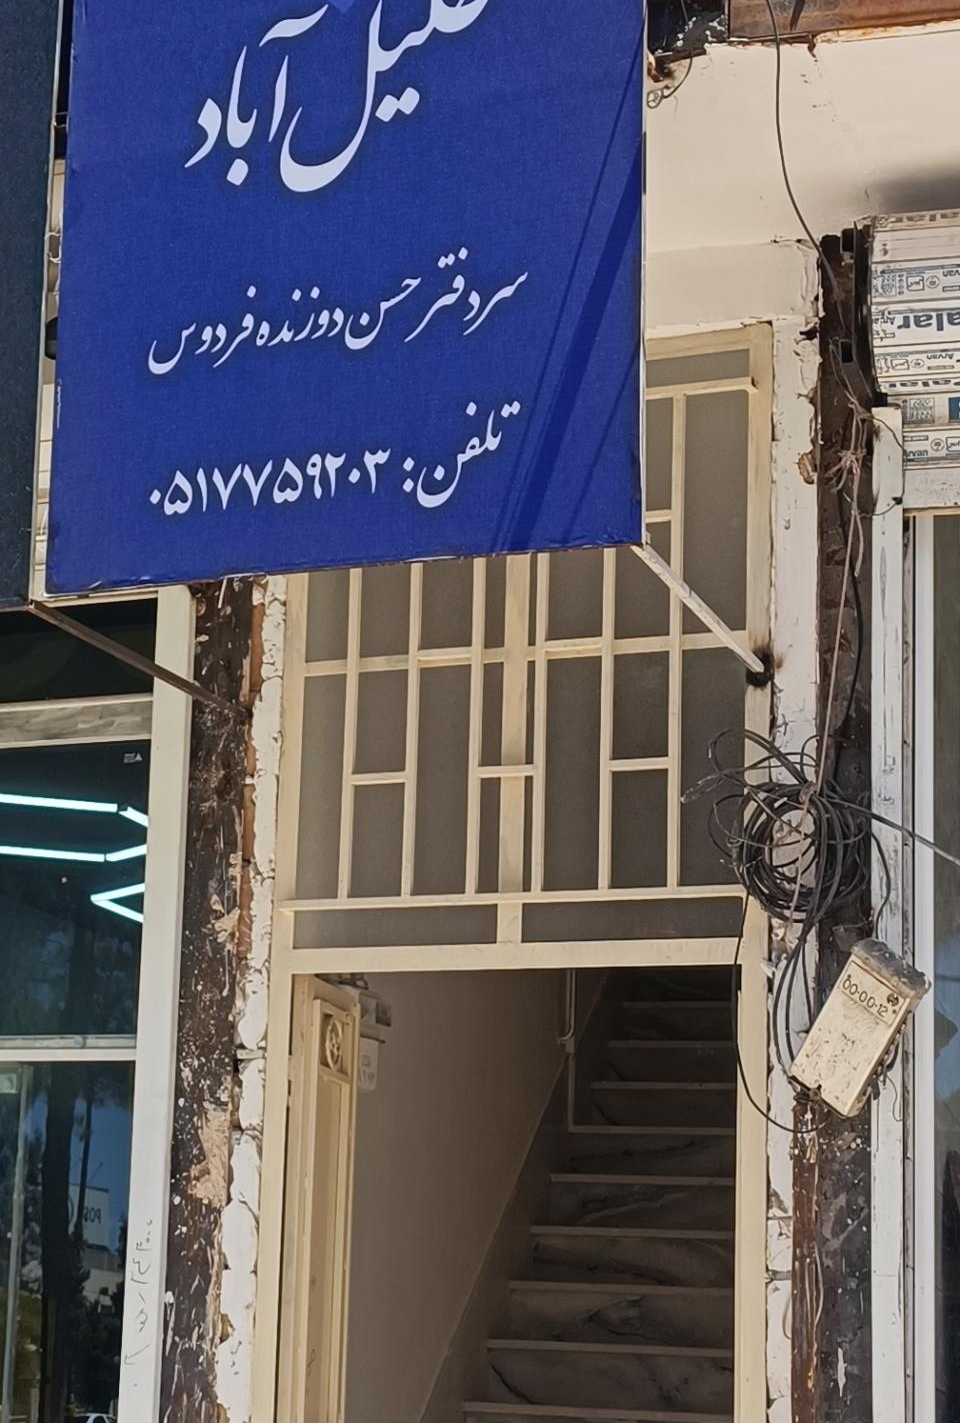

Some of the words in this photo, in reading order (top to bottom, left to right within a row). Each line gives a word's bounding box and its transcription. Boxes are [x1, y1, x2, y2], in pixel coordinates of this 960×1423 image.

[184, 4, 329, 186] آباد
[148, 285, 255, 375] فردوس
[346, 276, 422, 350] حسن
[897, 311, 960, 333] alar
[149, 448, 391, 515] ۰۵۱۷۷۵۹۲۰۳
[402, 400, 521, 508] تلفن:
